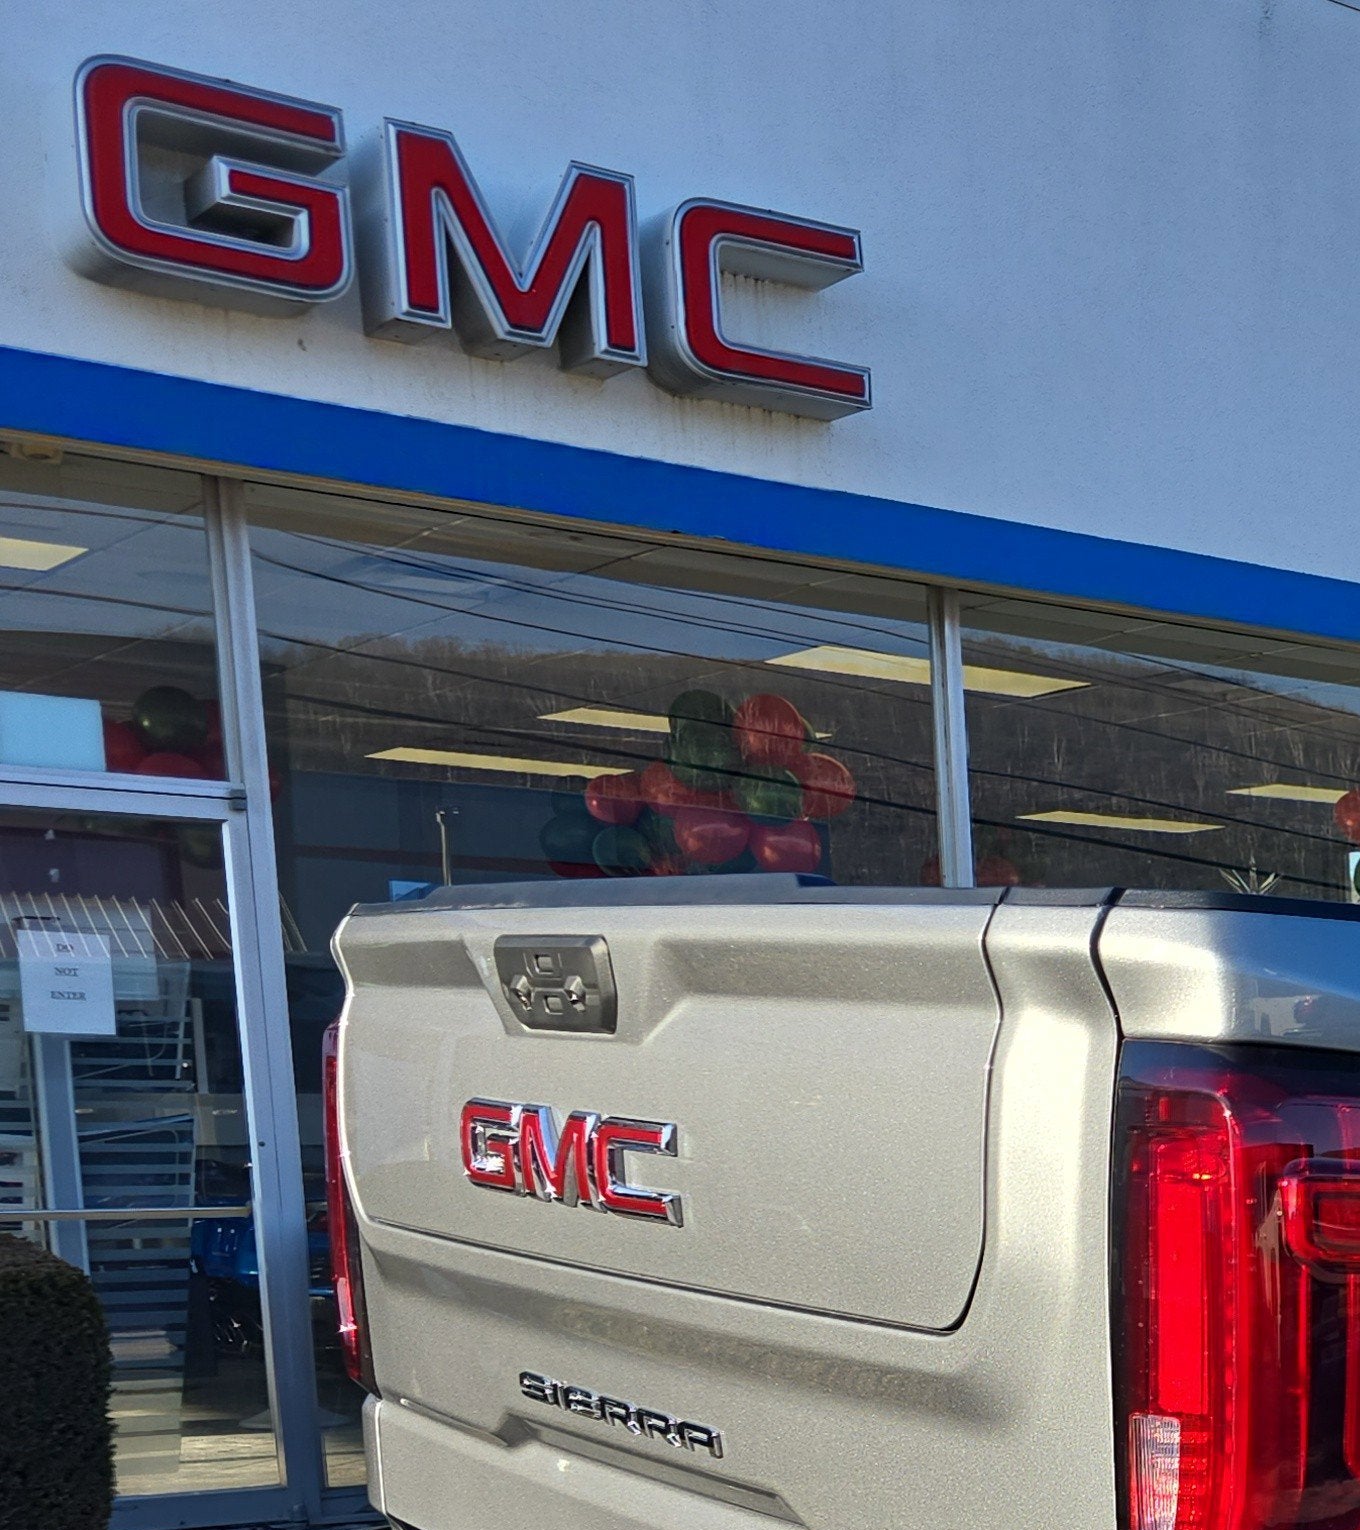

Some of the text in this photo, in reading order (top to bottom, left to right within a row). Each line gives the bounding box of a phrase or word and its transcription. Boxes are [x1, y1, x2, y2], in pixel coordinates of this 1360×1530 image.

[74, 53, 872, 418] GMC
[50, 990, 87, 1001] ENTER
[54, 966, 79, 977] NOT
[460, 1097, 684, 1228] GMC
[519, 1371, 724, 1459] SIERRA
